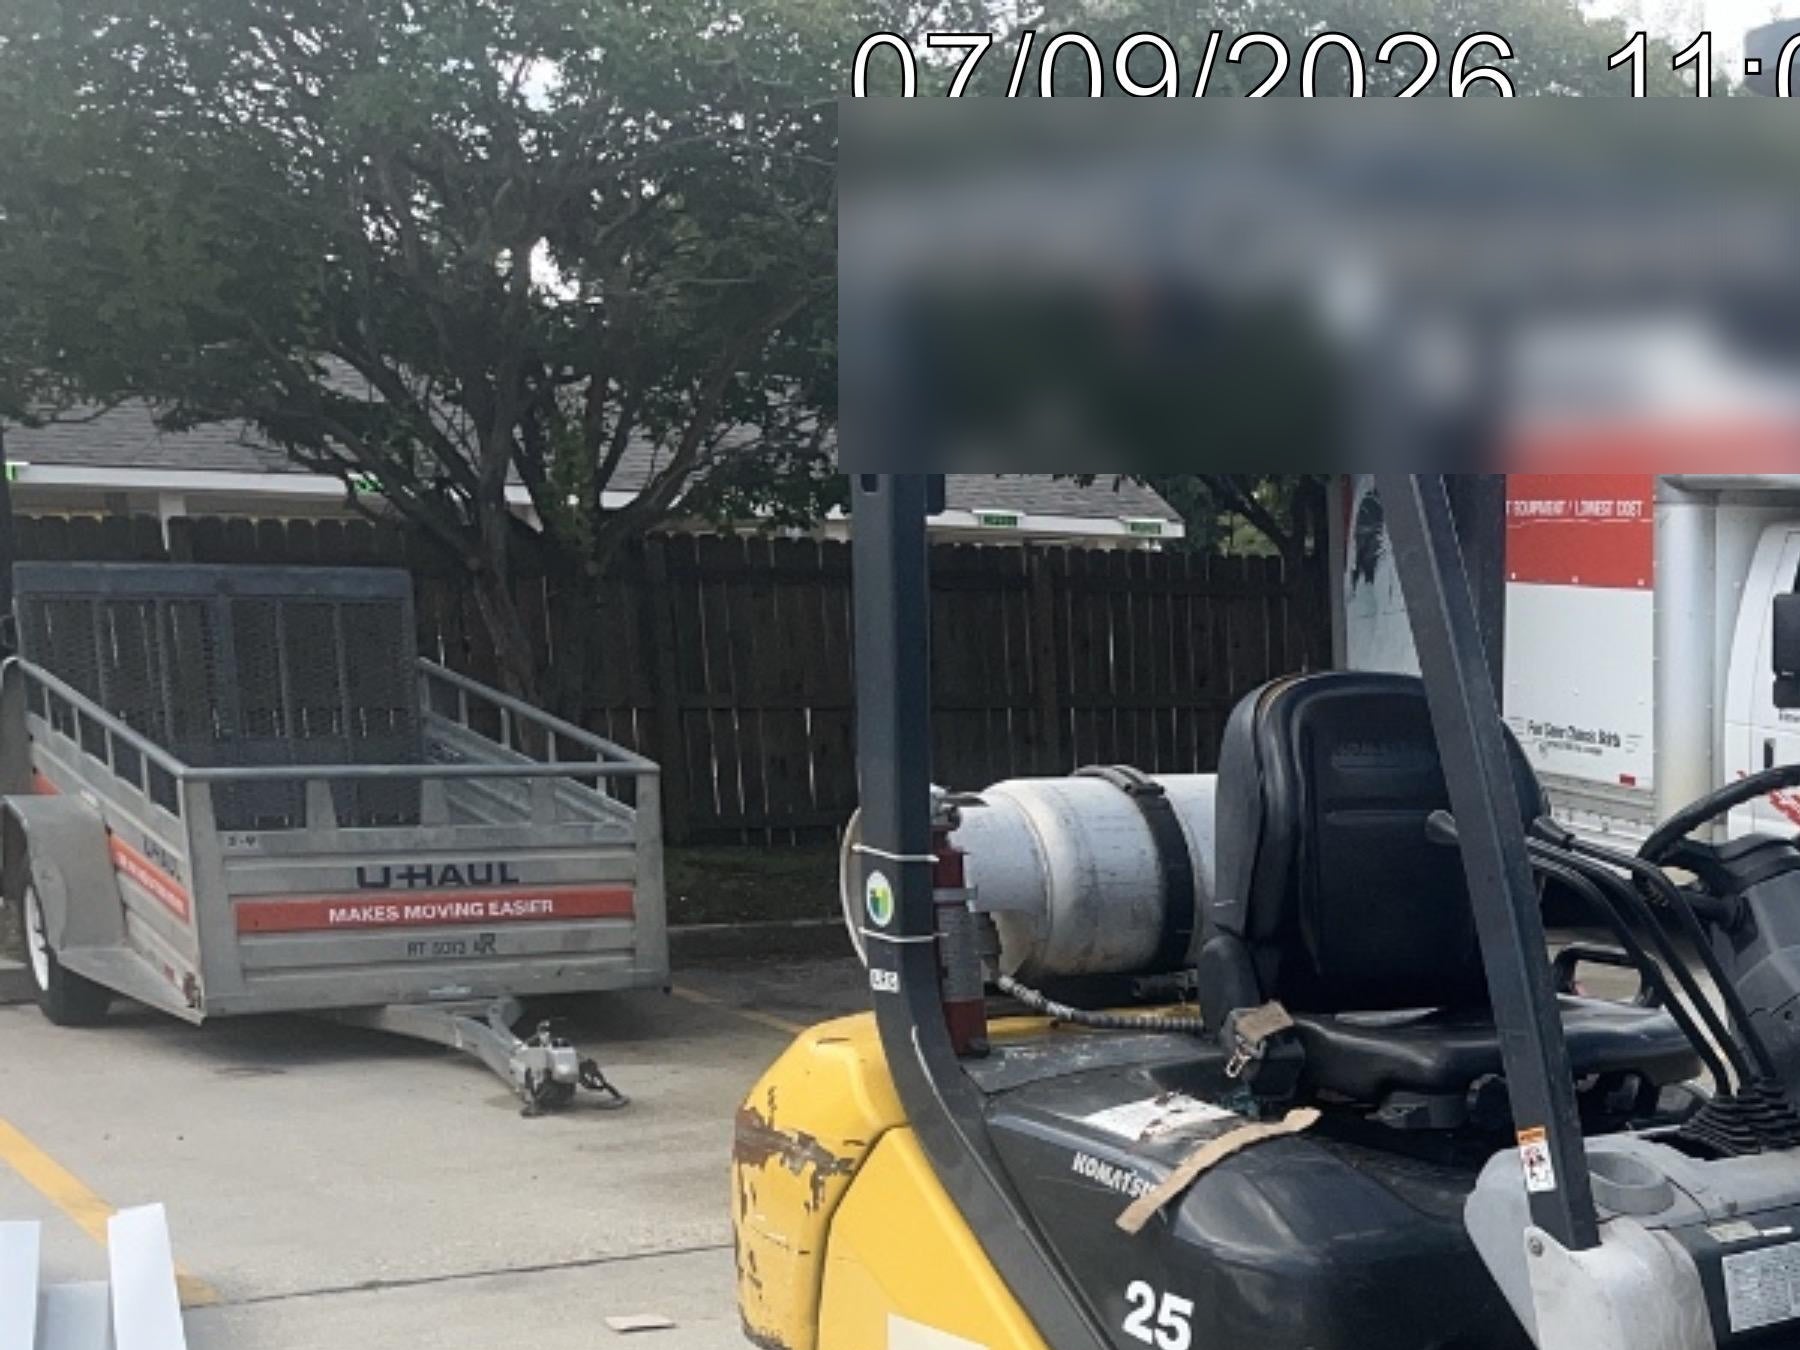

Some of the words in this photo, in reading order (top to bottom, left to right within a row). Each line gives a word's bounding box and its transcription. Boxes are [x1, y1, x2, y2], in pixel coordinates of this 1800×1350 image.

[356, 862, 520, 889] U-HAUL
[328, 905, 401, 924] MAKES
[404, 902, 485, 921] MOVING
[487, 898, 554, 916] EASIER
